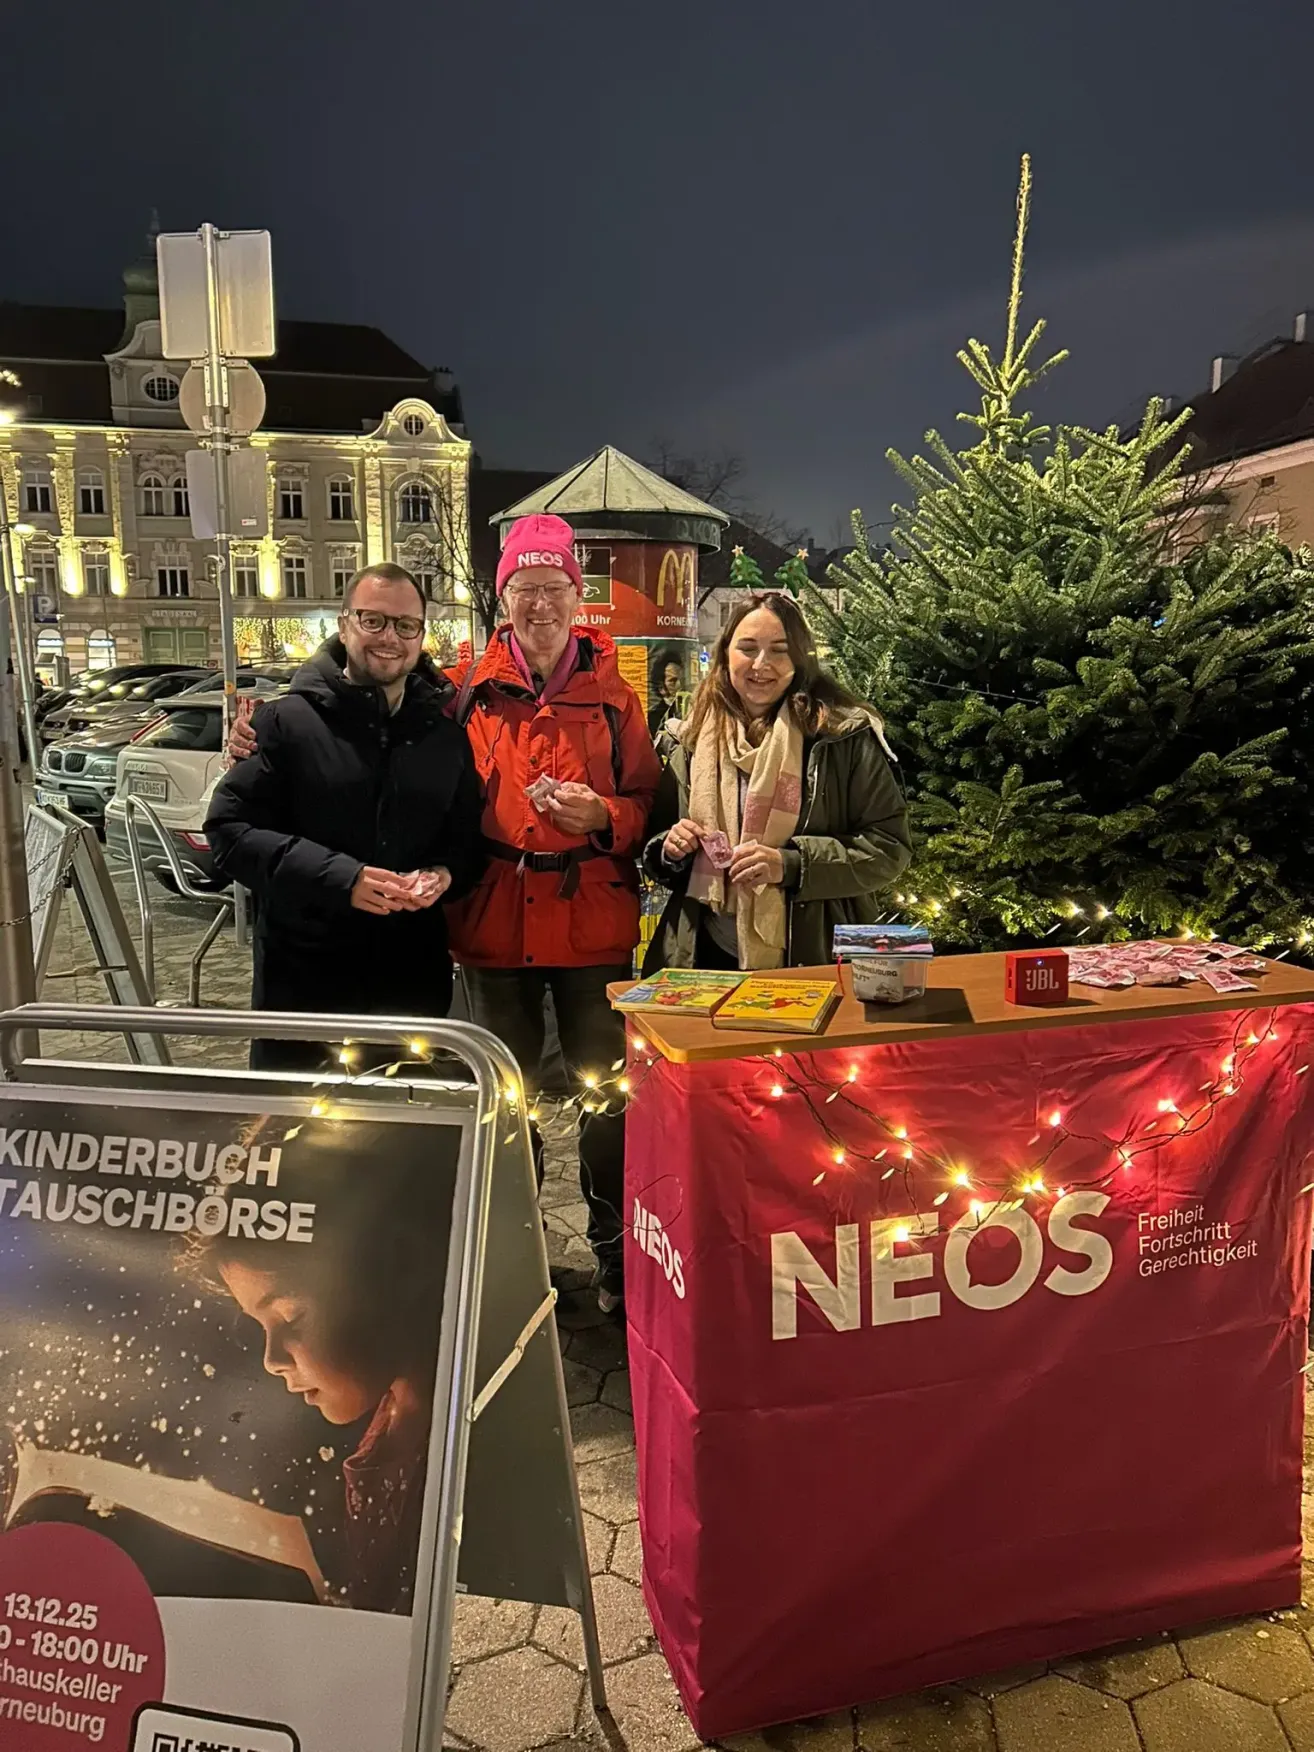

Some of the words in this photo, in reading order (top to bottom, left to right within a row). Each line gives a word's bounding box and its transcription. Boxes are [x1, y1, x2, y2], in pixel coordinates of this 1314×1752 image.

[518, 551, 563, 568] NEOS
[590, 614, 611, 625] Uhr
[656, 614, 692, 628] KORNE
[1025, 968, 1060, 991] JBL
[0, 1127, 282, 1187] KINDERBUCH
[1138, 1205, 1205, 1232] Freiheit
[634, 1197, 685, 1299] NEOS
[1139, 1222, 1232, 1255] Fortschritt
[770, 1190, 1113, 1340] NEOS
[1139, 1240, 1258, 1277] Gerechtigkeit
[5, 1593, 98, 1630] 13.12.25
[31, 1631, 98, 1664] 18:00
[102, 1641, 149, 1674] Uhr
[0, 1657, 123, 1704] hauskeller
